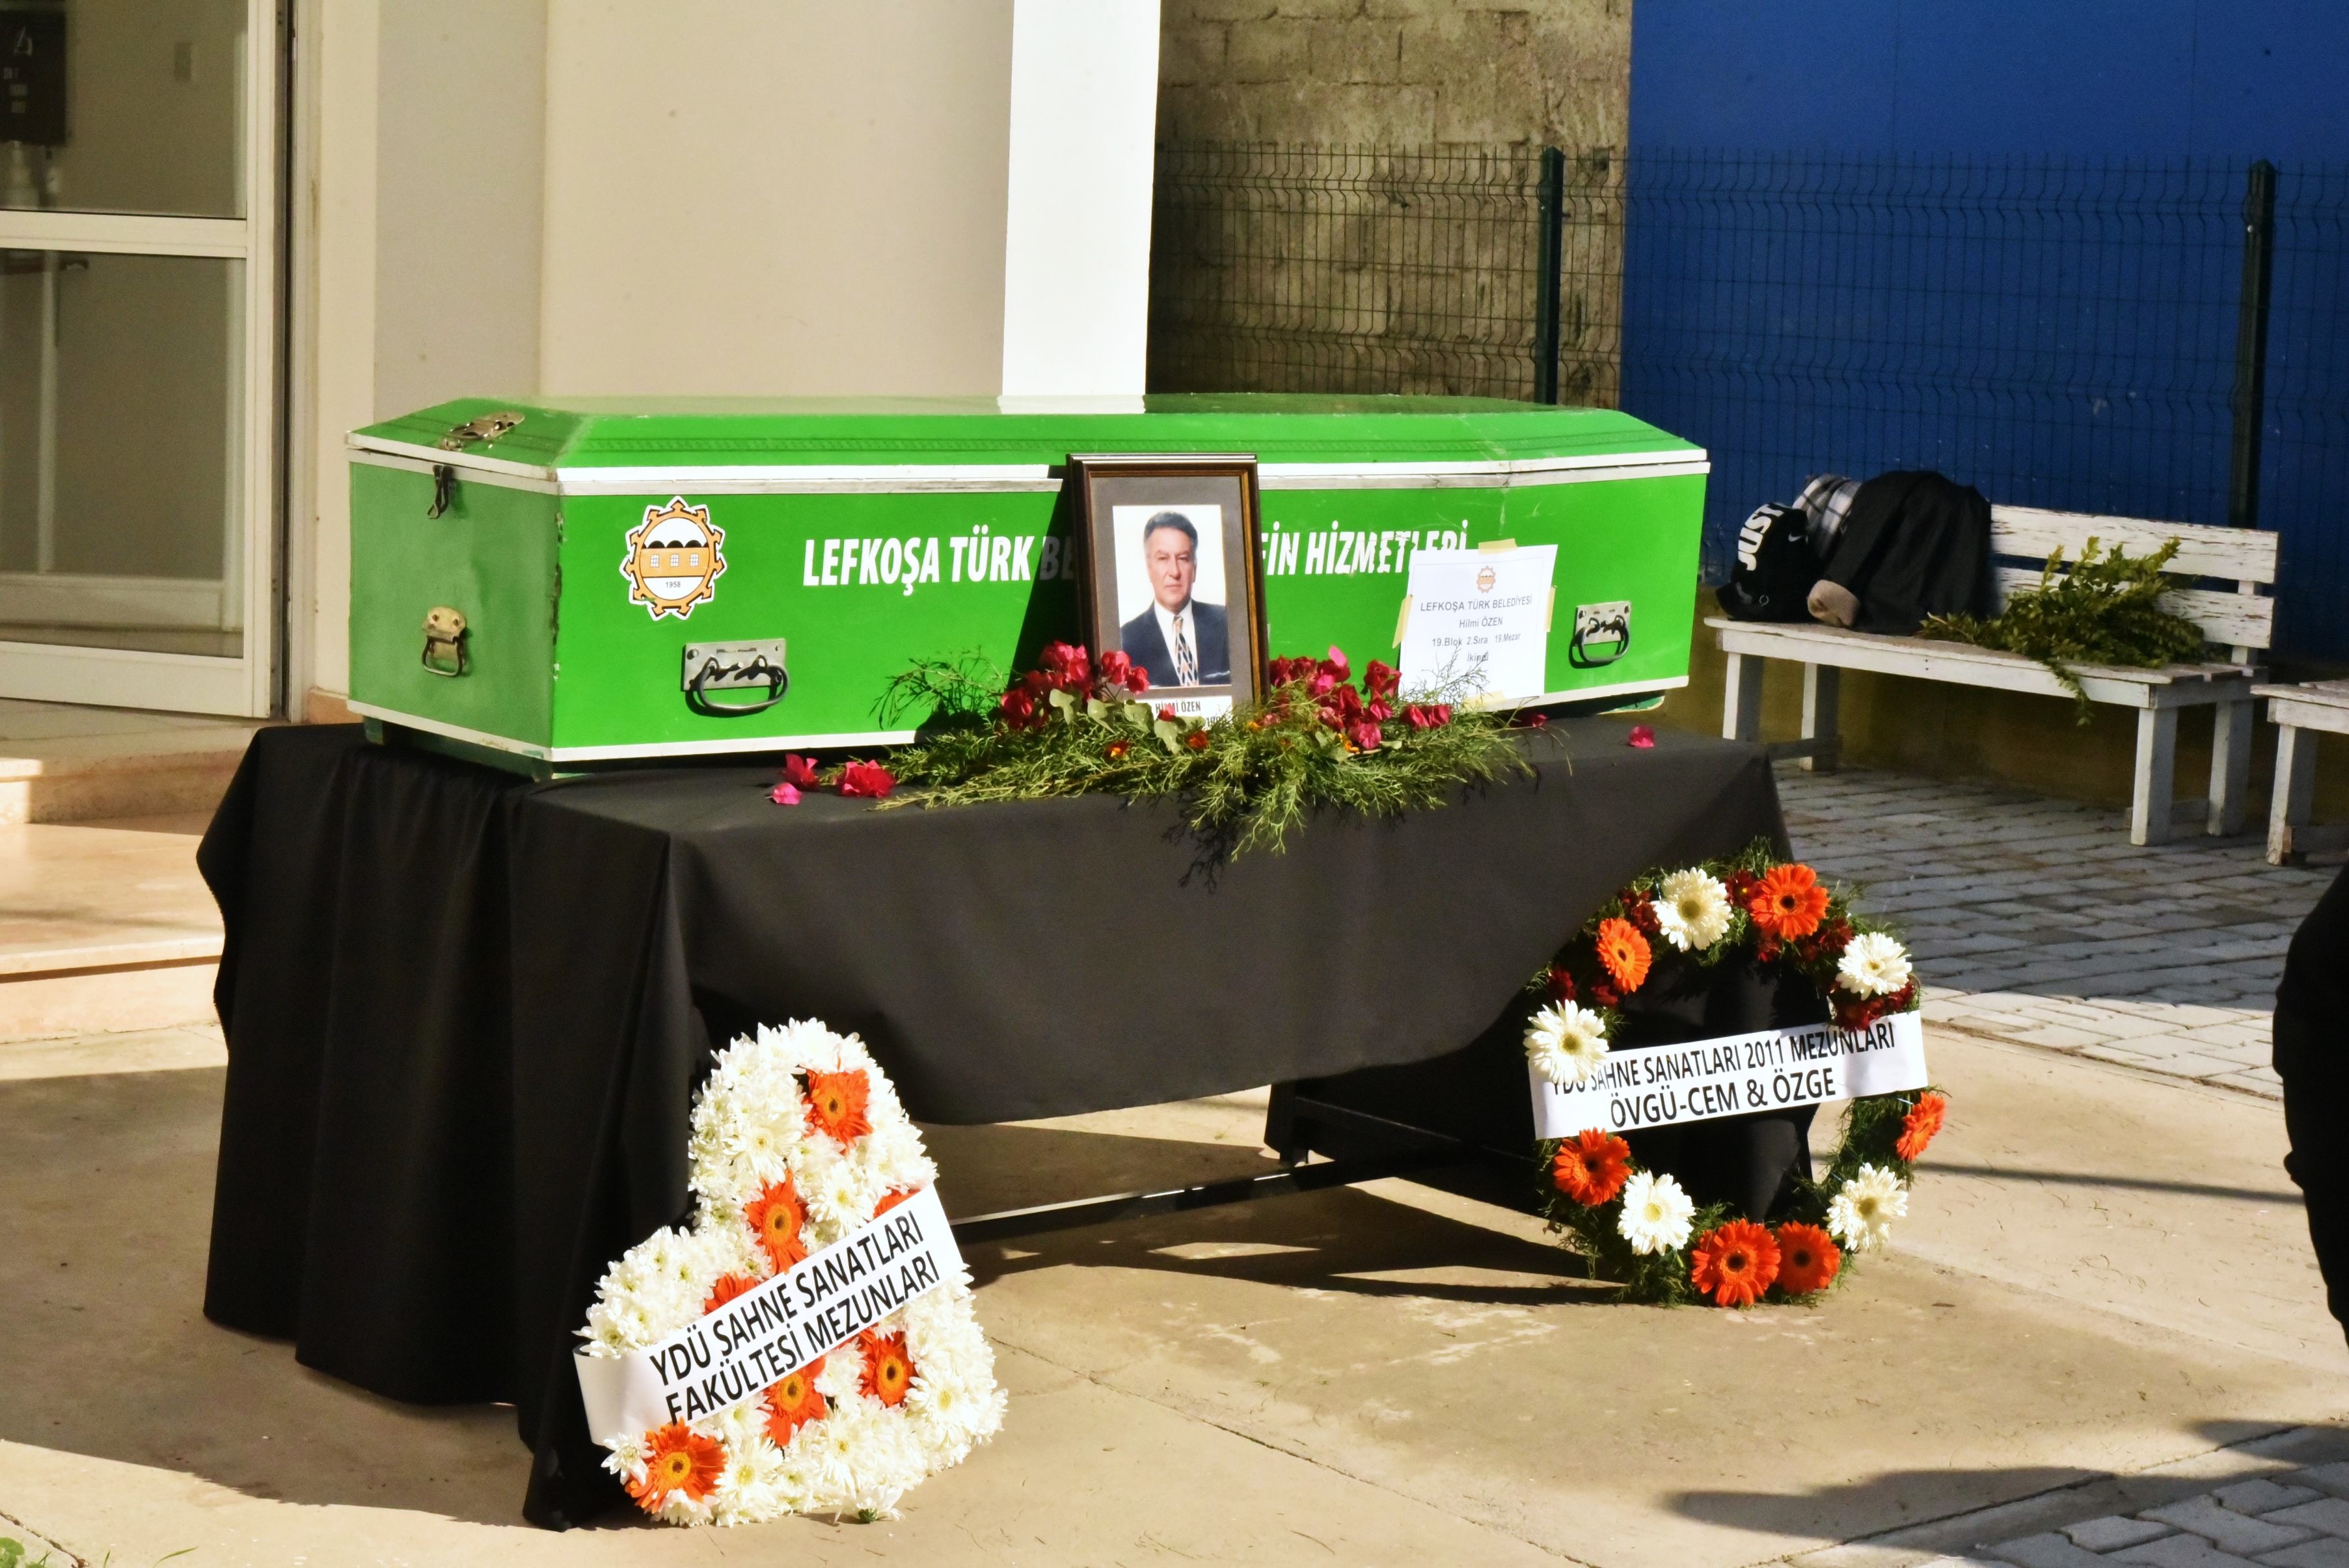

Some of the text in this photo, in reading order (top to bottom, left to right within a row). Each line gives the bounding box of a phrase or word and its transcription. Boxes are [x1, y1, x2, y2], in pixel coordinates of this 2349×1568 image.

[803, 537, 940, 596] LEFKOŞA
[950, 524, 1035, 582] TÜRK
[1420, 593, 1532, 612] LEFKOŞA TÜRK BELEDİYESİ
[1459, 615, 1503, 629] Hilmi ÖZEN
[1432, 633, 1521, 647] 19.Blok 2.Sıra 19.Mezar
[1181, 699, 1201, 712] ÖZEN
[1590, 1059, 1641, 1091] SAHNE
[1644, 1044, 1741, 1084] SANATLARI
[1745, 1038, 1784, 1069] 2011
[1789, 1021, 1895, 1062] MEZUNLARI
[1610, 1068, 1836, 1128] ÖVGÜ-CEM & ÖZGE
[649, 1210, 924, 1386] YDÜ SAHNE SANATLARI
[666, 1250, 940, 1426] FAKÜLTESİ MEZUNLARI
